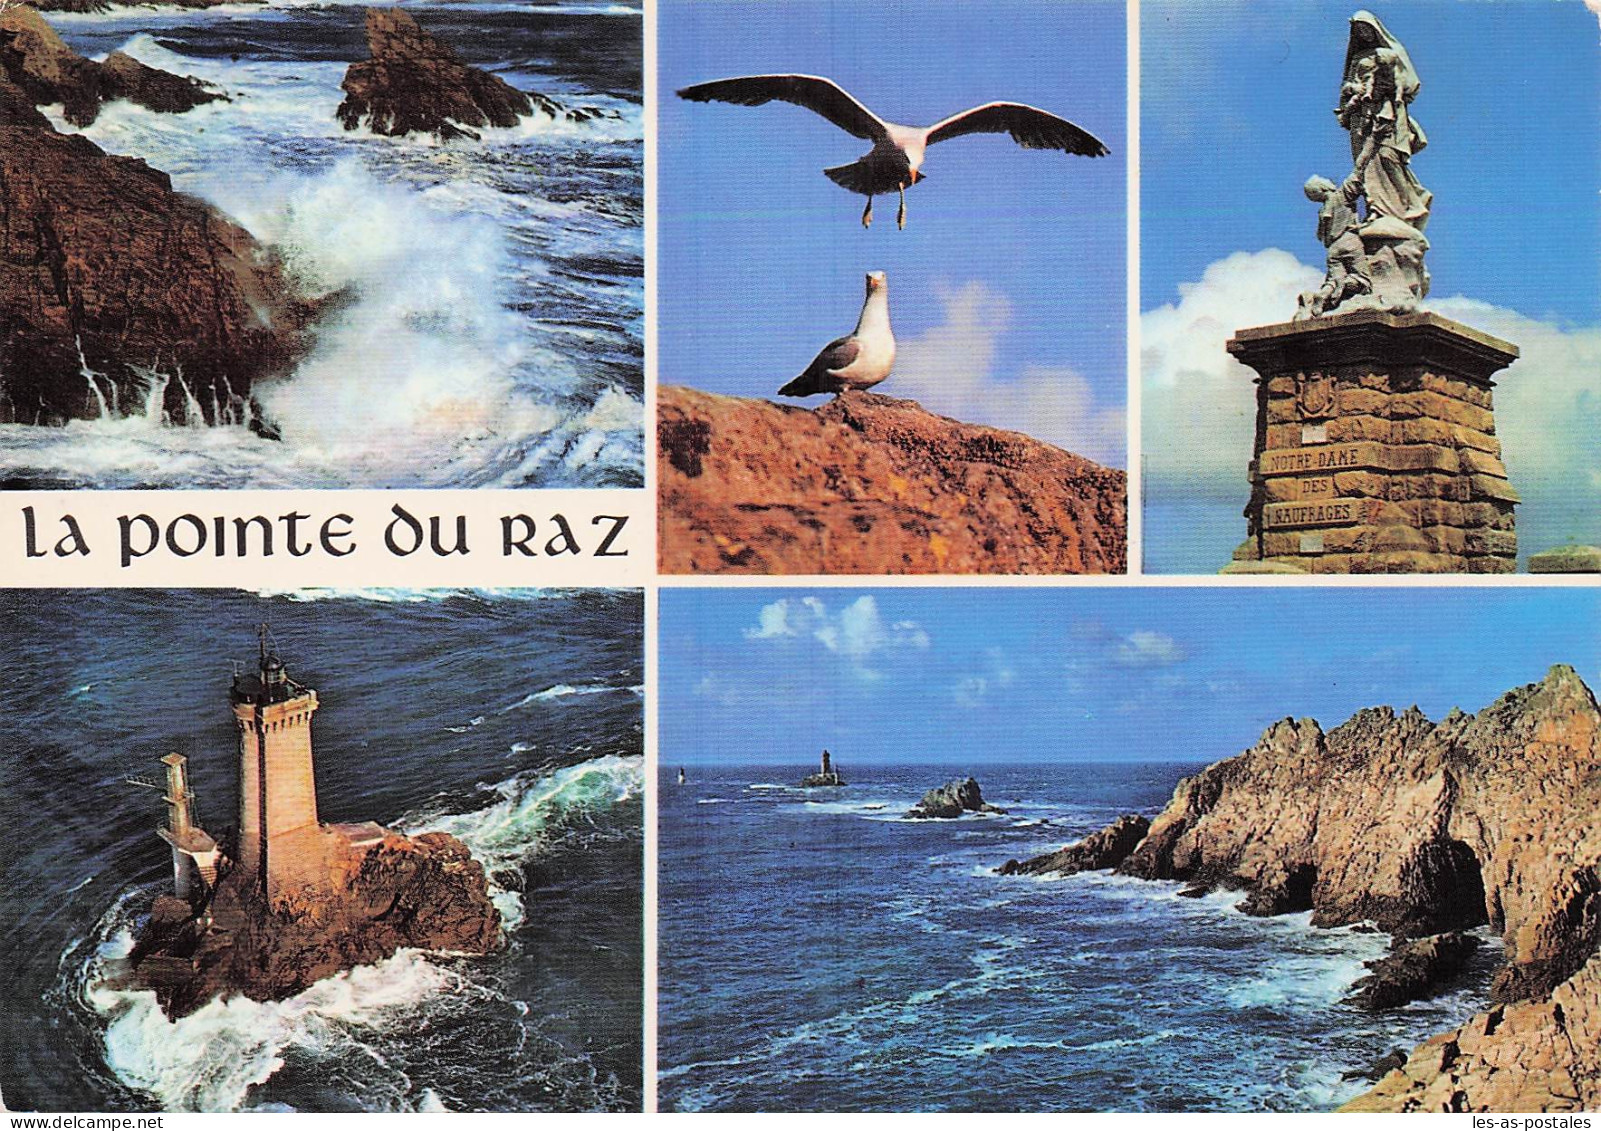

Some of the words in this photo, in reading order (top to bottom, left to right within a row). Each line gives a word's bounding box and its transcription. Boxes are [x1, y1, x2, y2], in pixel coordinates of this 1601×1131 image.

[1271, 448, 1359, 471] NOTRE-DAME
[1302, 479, 1328, 494] DES
[1274, 503, 1351, 525] NAUFRAGES
[384, 503, 470, 557] du
